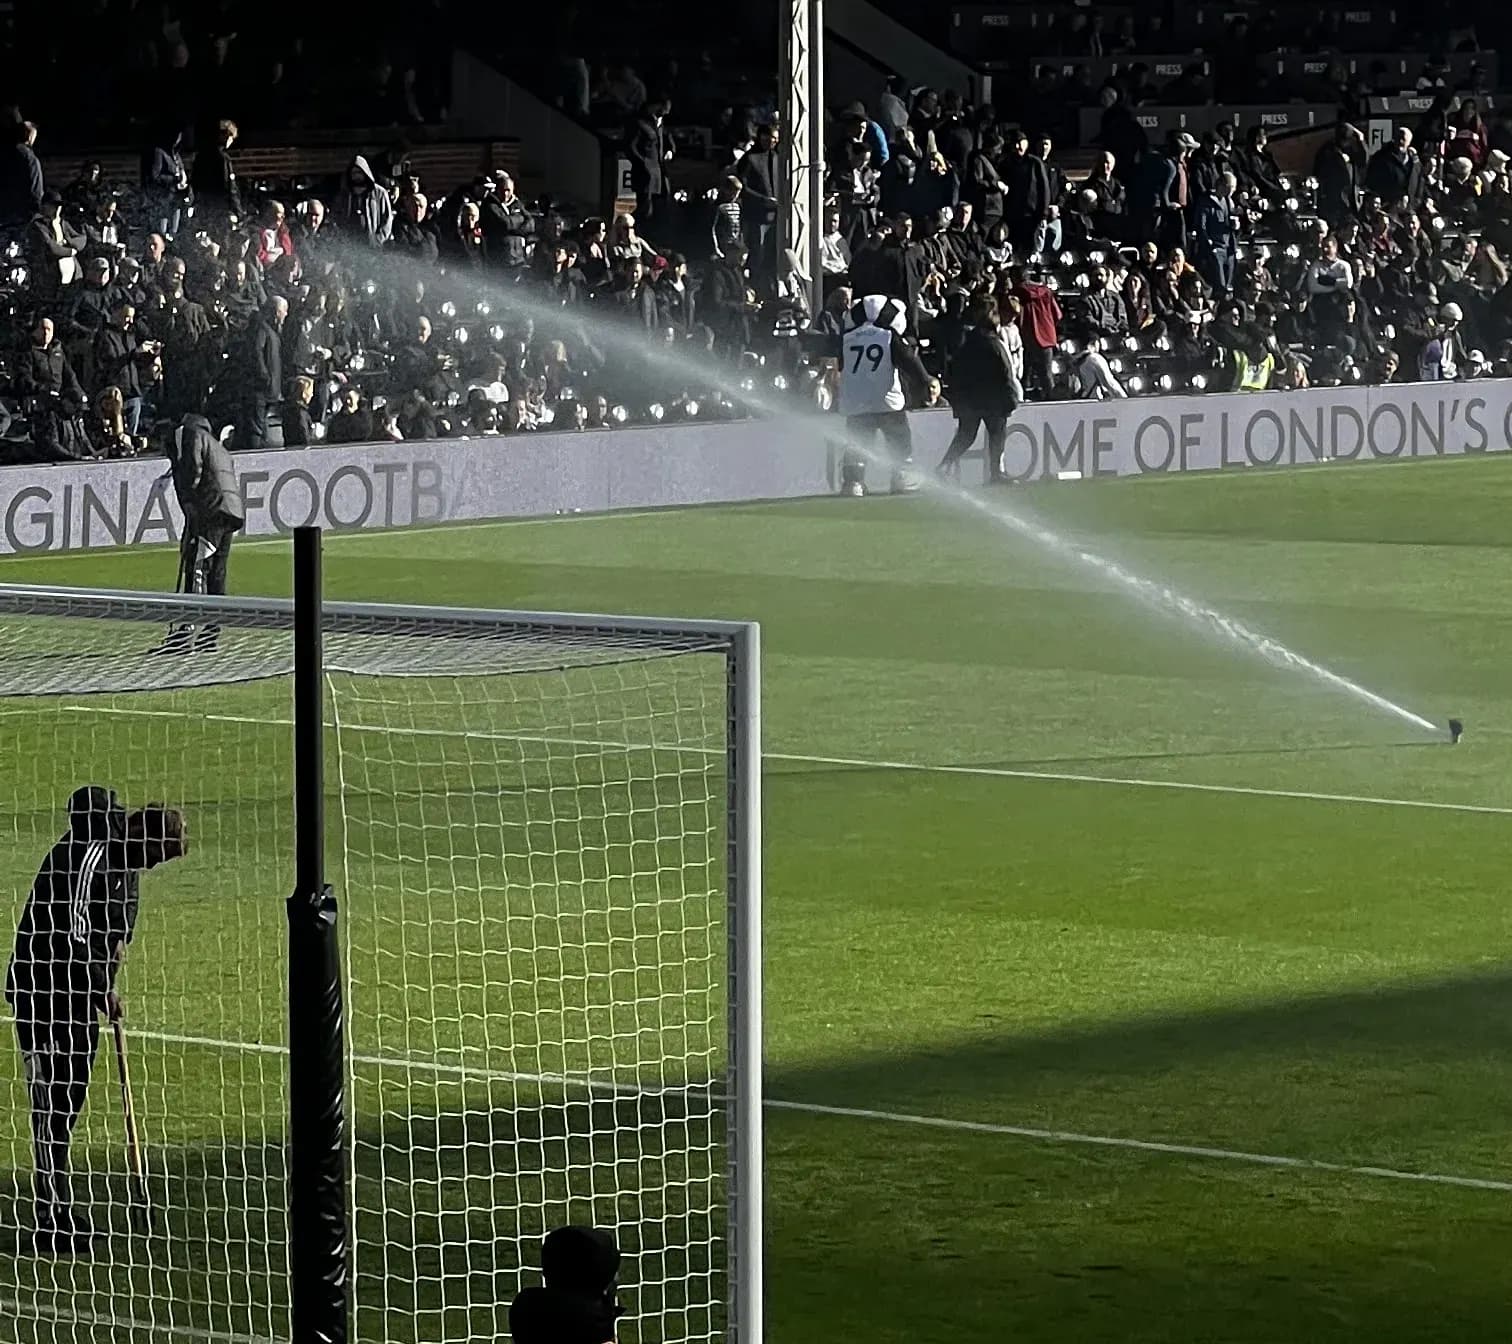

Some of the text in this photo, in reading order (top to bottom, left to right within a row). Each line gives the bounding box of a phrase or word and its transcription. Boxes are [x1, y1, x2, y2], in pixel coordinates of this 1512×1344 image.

[1155, 64, 1183, 75] PRESS
[1261, 113, 1288, 126] PRESS
[850, 344, 884, 374] 79
[1135, 414, 1204, 474] OF
[1221, 398, 1488, 466] LONDON'S
